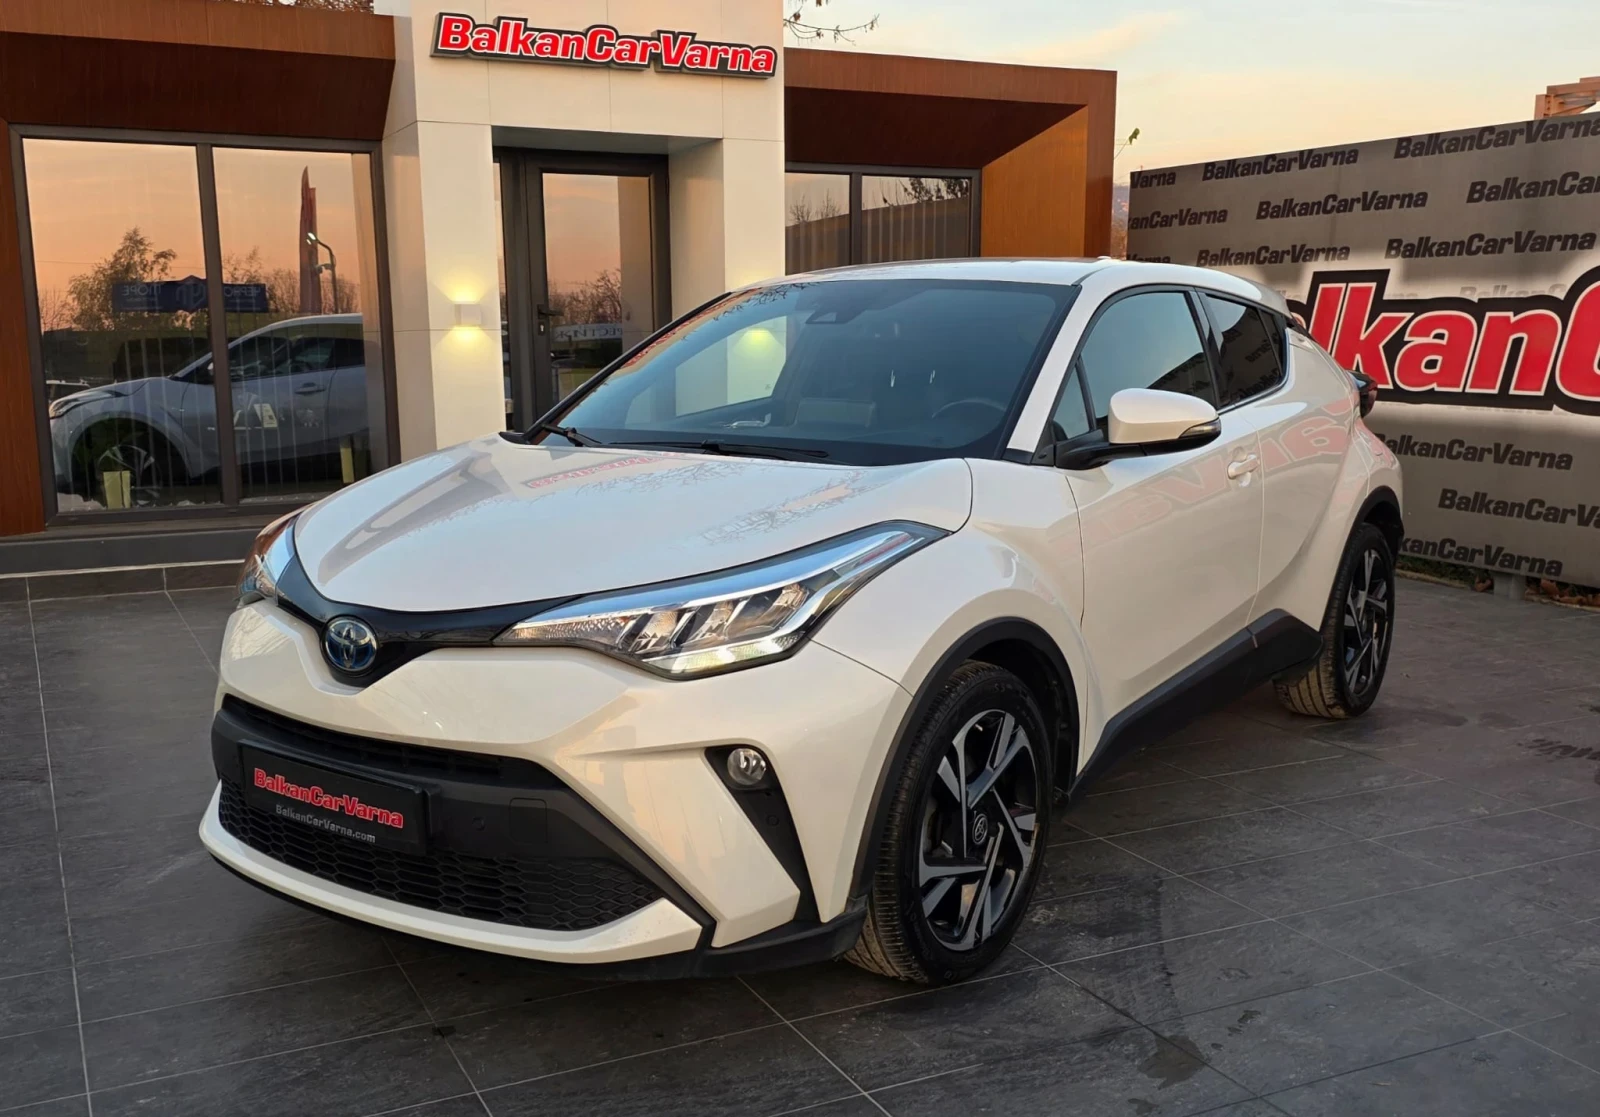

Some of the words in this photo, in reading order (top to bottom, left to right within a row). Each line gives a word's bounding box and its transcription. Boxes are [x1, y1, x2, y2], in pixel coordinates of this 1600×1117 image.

[438, 15, 775, 73] BalkanCarVarna
[1394, 118, 1600, 159] BalkanCarVarna
[1130, 171, 1176, 189] Varna
[1202, 148, 1359, 181] BalkanCarVarna
[1256, 191, 1428, 220] BalkanCarVarna
[1196, 244, 1350, 267] BalkanCarVarna
[1384, 230, 1597, 259] BalkanCarVarna
[1290, 281, 1600, 402] lkan
[254, 768, 404, 828] BalkanCarVarna
[275, 804, 376, 843] BalkanCarVarna.com
